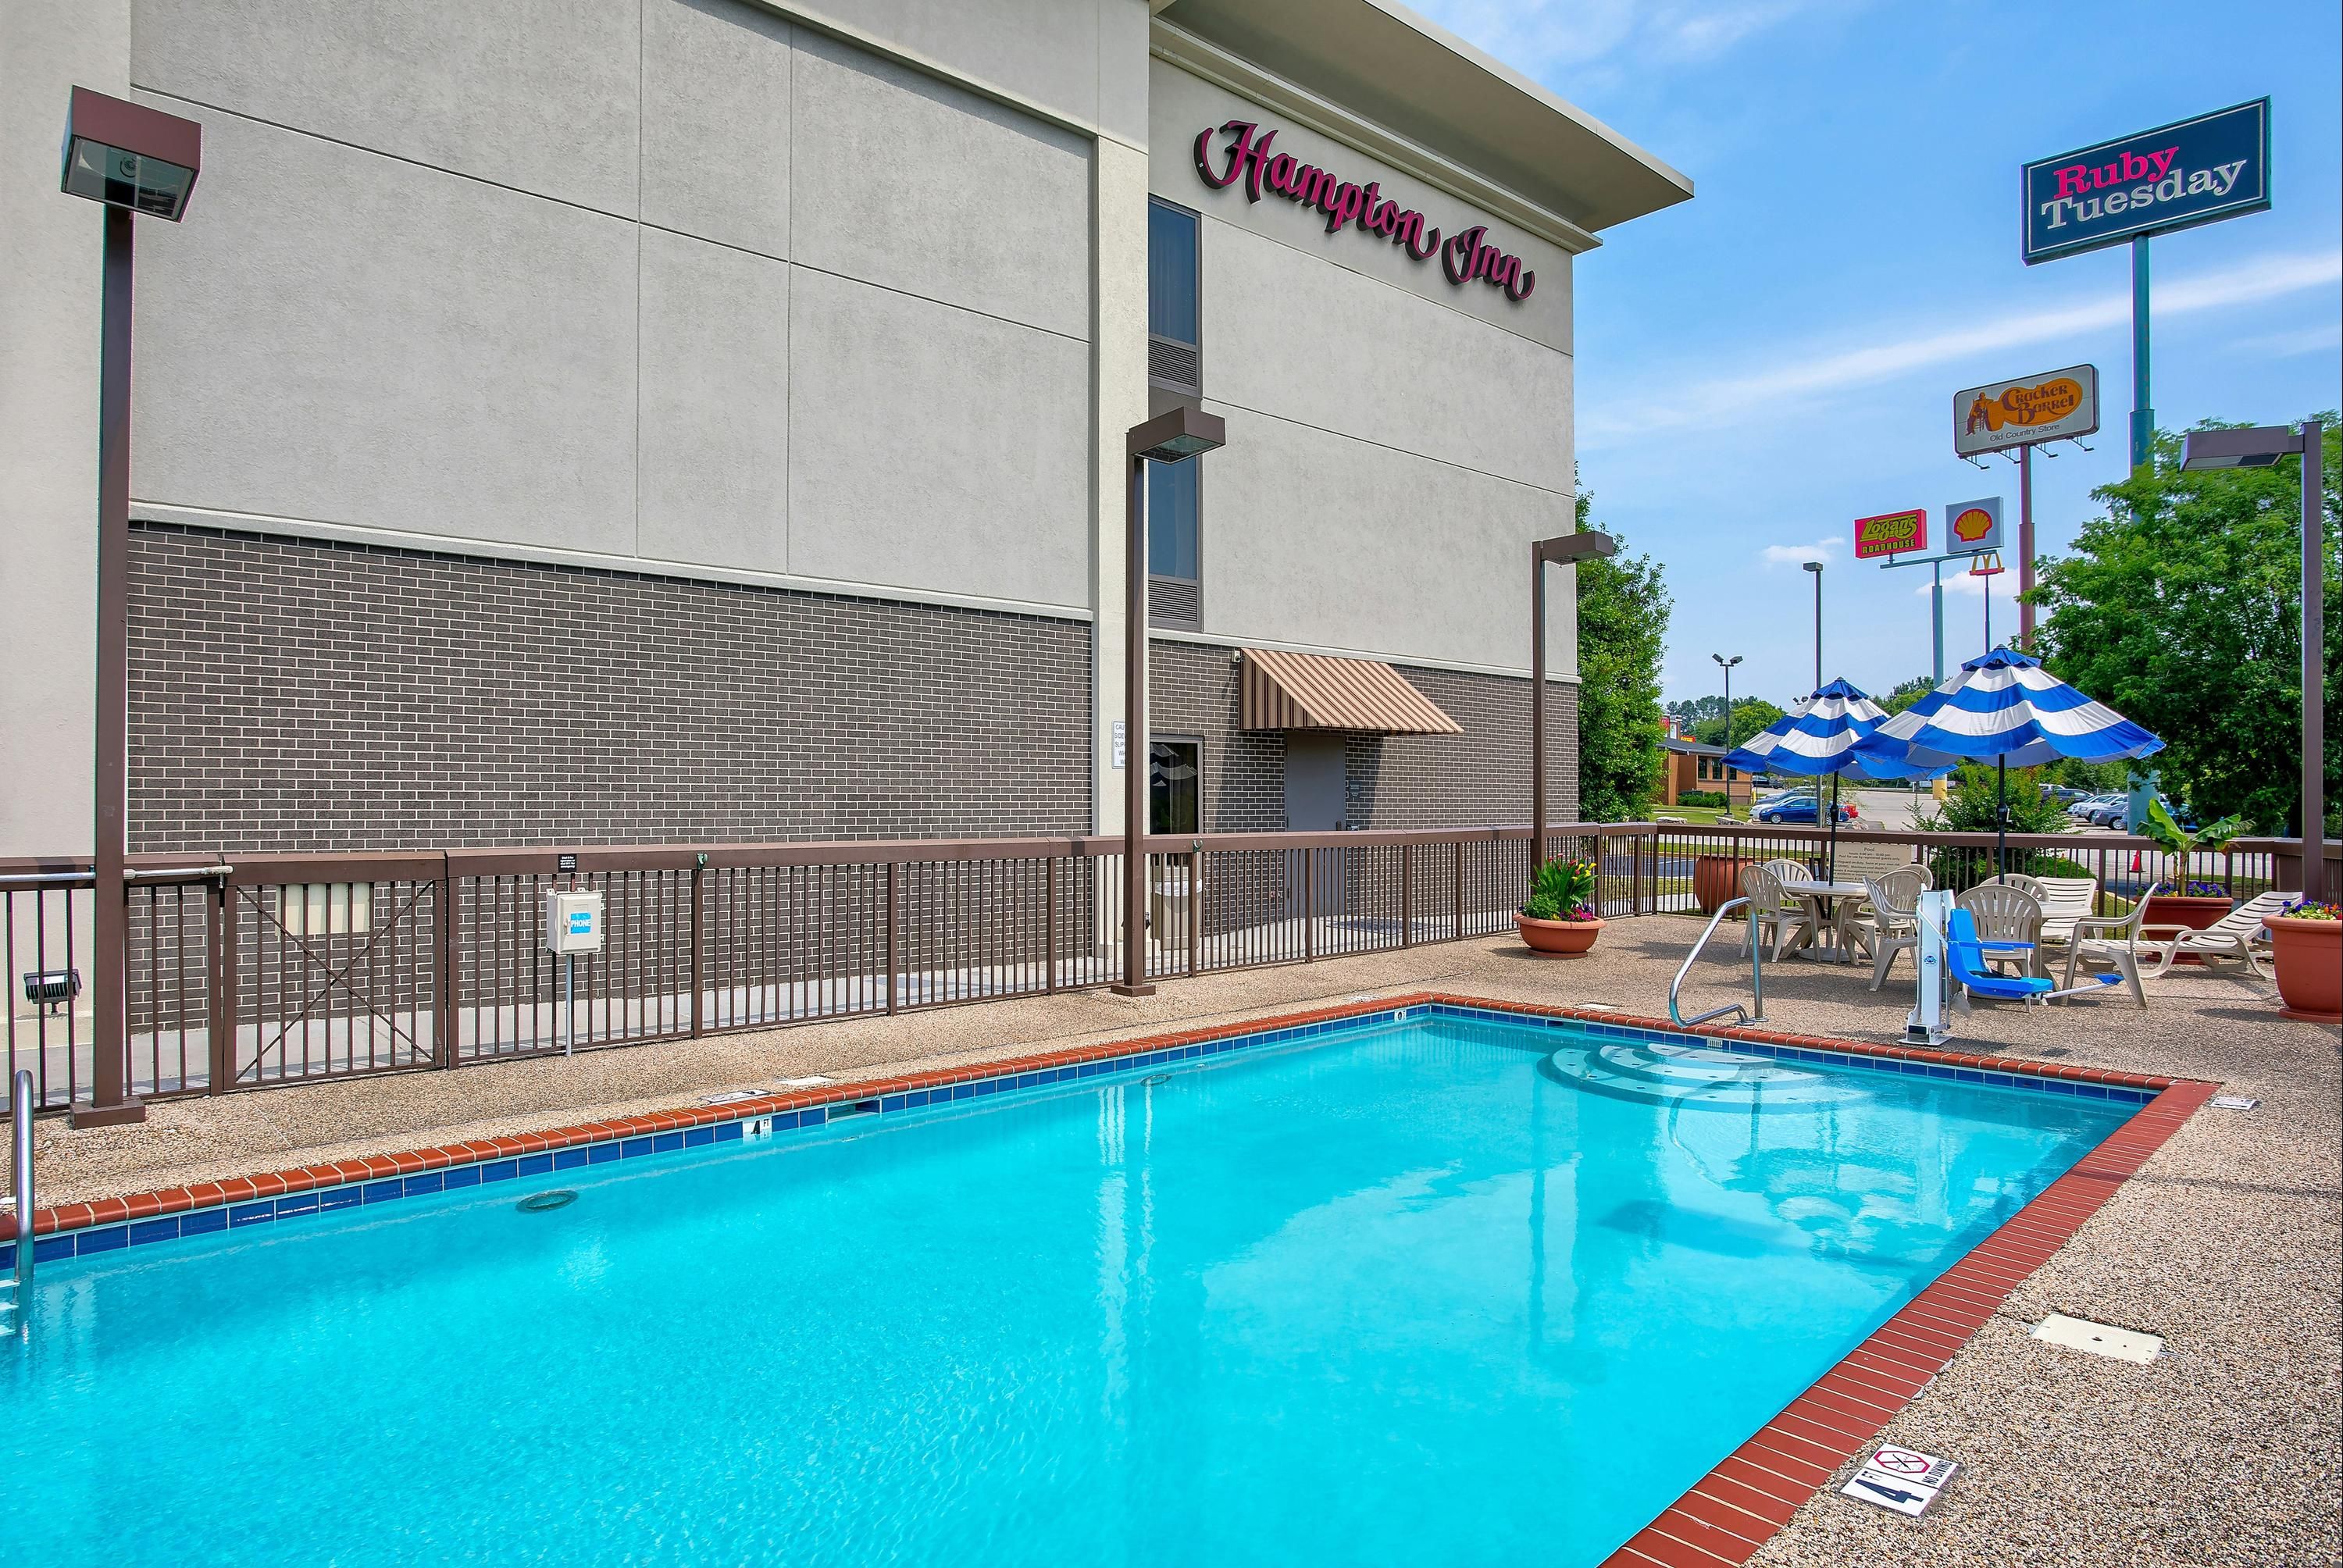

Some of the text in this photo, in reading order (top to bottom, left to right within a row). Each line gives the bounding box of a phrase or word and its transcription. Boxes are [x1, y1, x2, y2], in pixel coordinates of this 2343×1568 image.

[2053, 146, 2179, 199] Ruby
[2041, 159, 2247, 230] Tuesday
[1194, 119, 1536, 301] Hampton Inn
[2002, 384, 2068, 412] Cracker
[2018, 394, 2075, 424] Barrel
[1989, 423, 2060, 443] Old Country Store
[1860, 514, 1918, 543] Logan's
[1862, 539, 1916, 554] ROADHOUSE
[571, 919, 591, 928] PHONE
[1922, 1459, 1953, 1486] NO DIVING
[1854, 1477, 1924, 1504] 4
